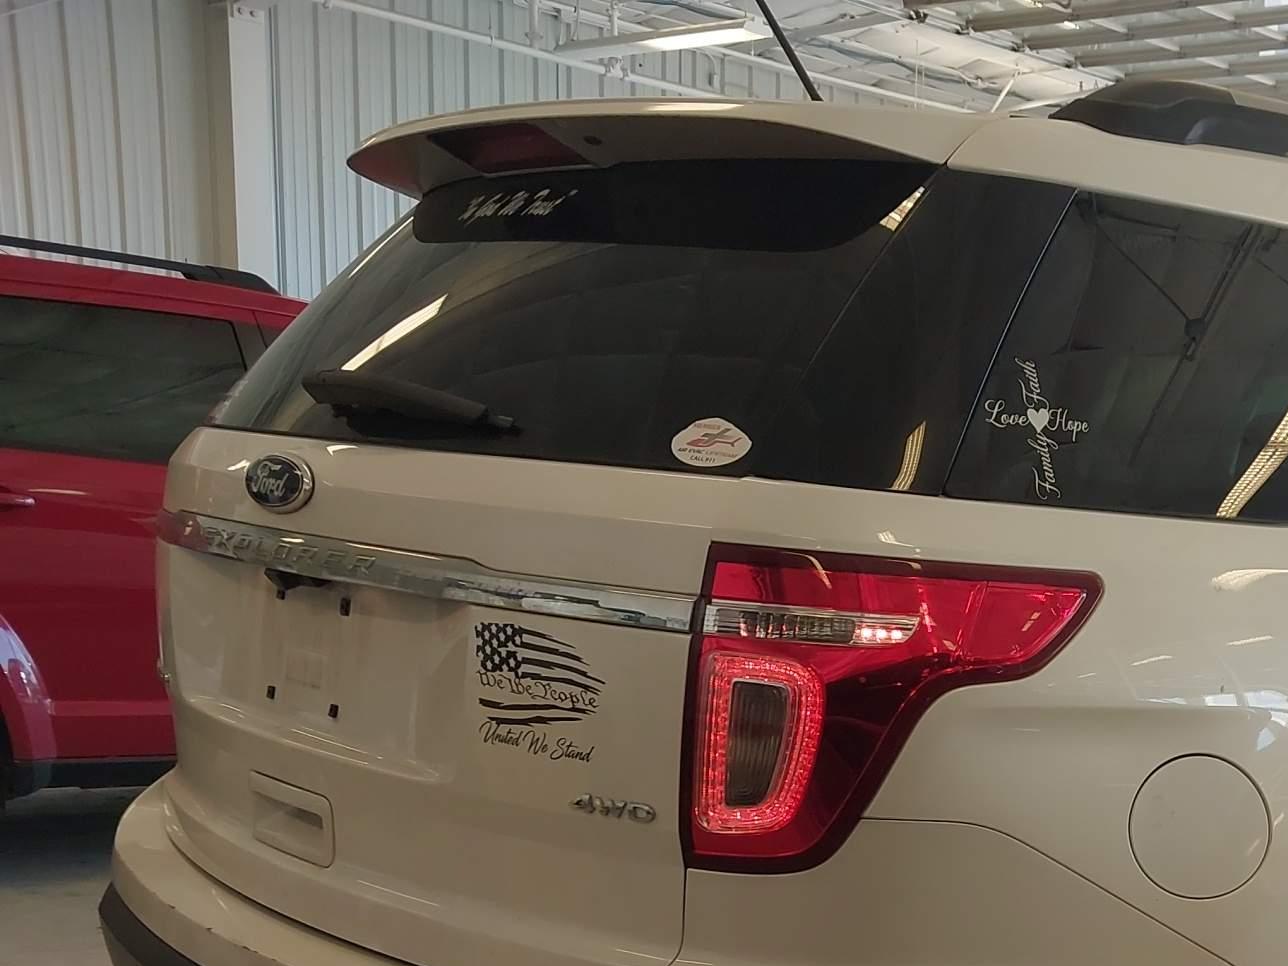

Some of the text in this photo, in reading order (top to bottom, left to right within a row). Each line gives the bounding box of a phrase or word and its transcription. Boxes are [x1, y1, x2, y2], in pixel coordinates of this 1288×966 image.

[1014, 357, 1050, 411] Faith
[984, 400, 1090, 442] Love Hope
[251, 460, 289, 497] Ford
[689, 454, 704, 462] CALL
[1027, 432, 1061, 500] Family
[201, 525, 377, 575] EXPLORER
[476, 670, 601, 709] We The People
[479, 720, 595, 763] United We Stand
[570, 792, 657, 823] 4WD
